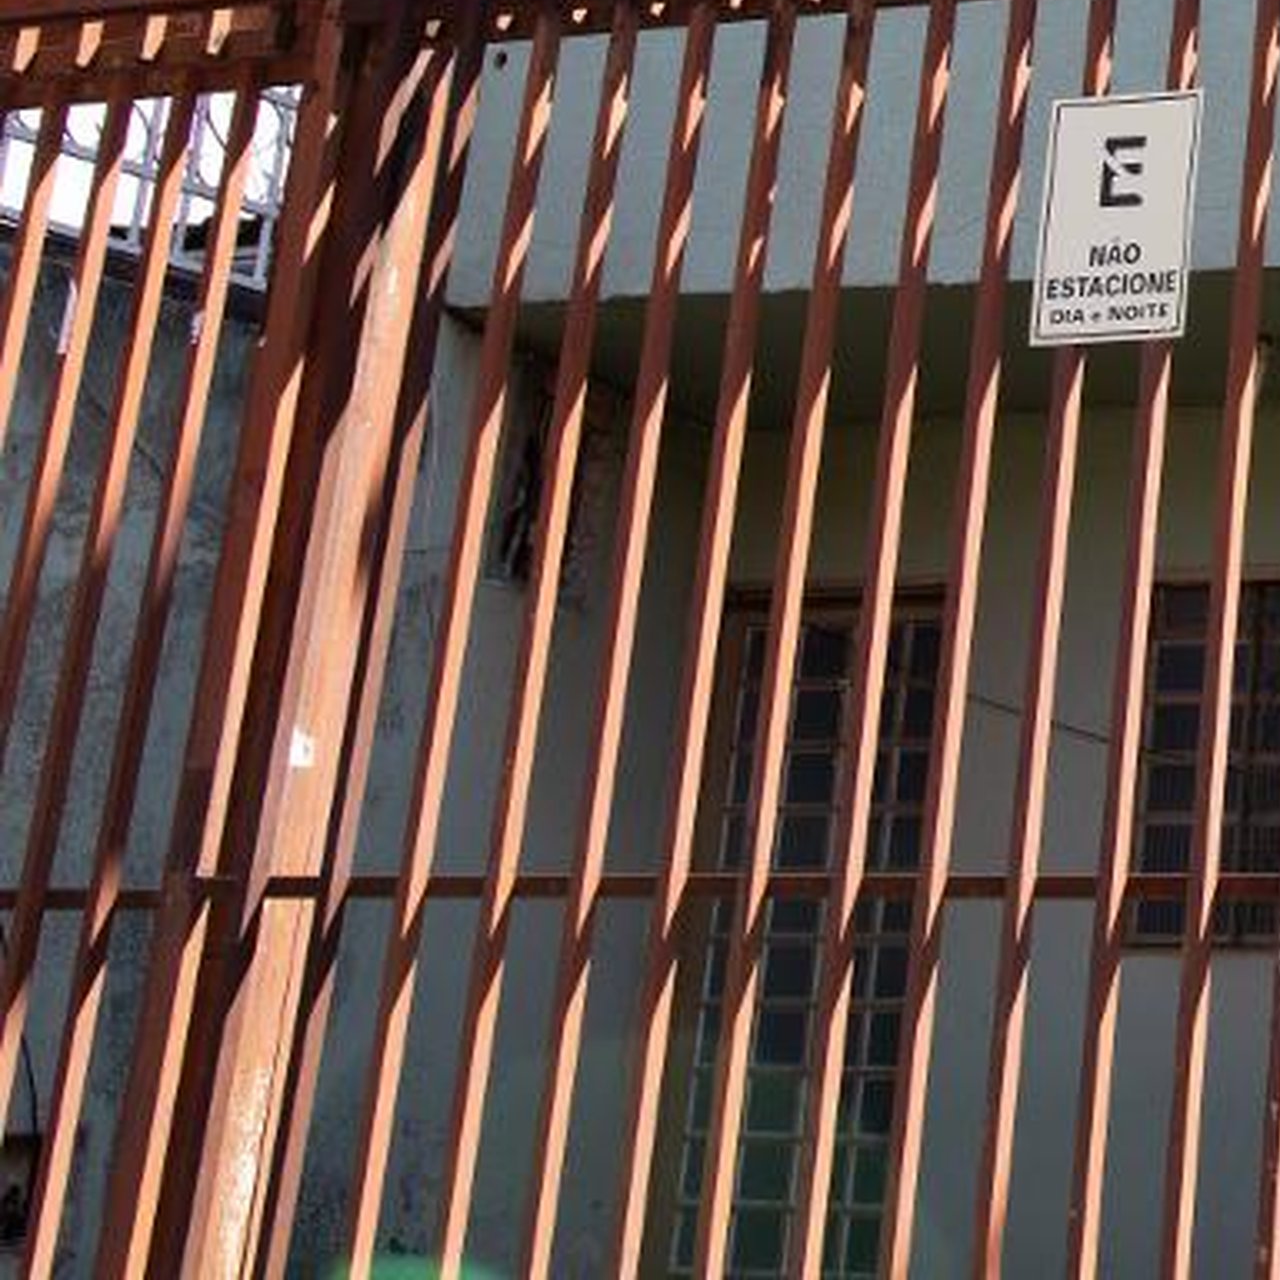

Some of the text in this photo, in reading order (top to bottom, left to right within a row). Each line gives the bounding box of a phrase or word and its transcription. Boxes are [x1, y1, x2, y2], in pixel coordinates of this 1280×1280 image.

[1089, 235, 1142, 267] NÃO
[1046, 270, 1177, 300] ESTACIONE
[1049, 308, 1085, 325] DIA
[1107, 302, 1169, 321] NOITE
